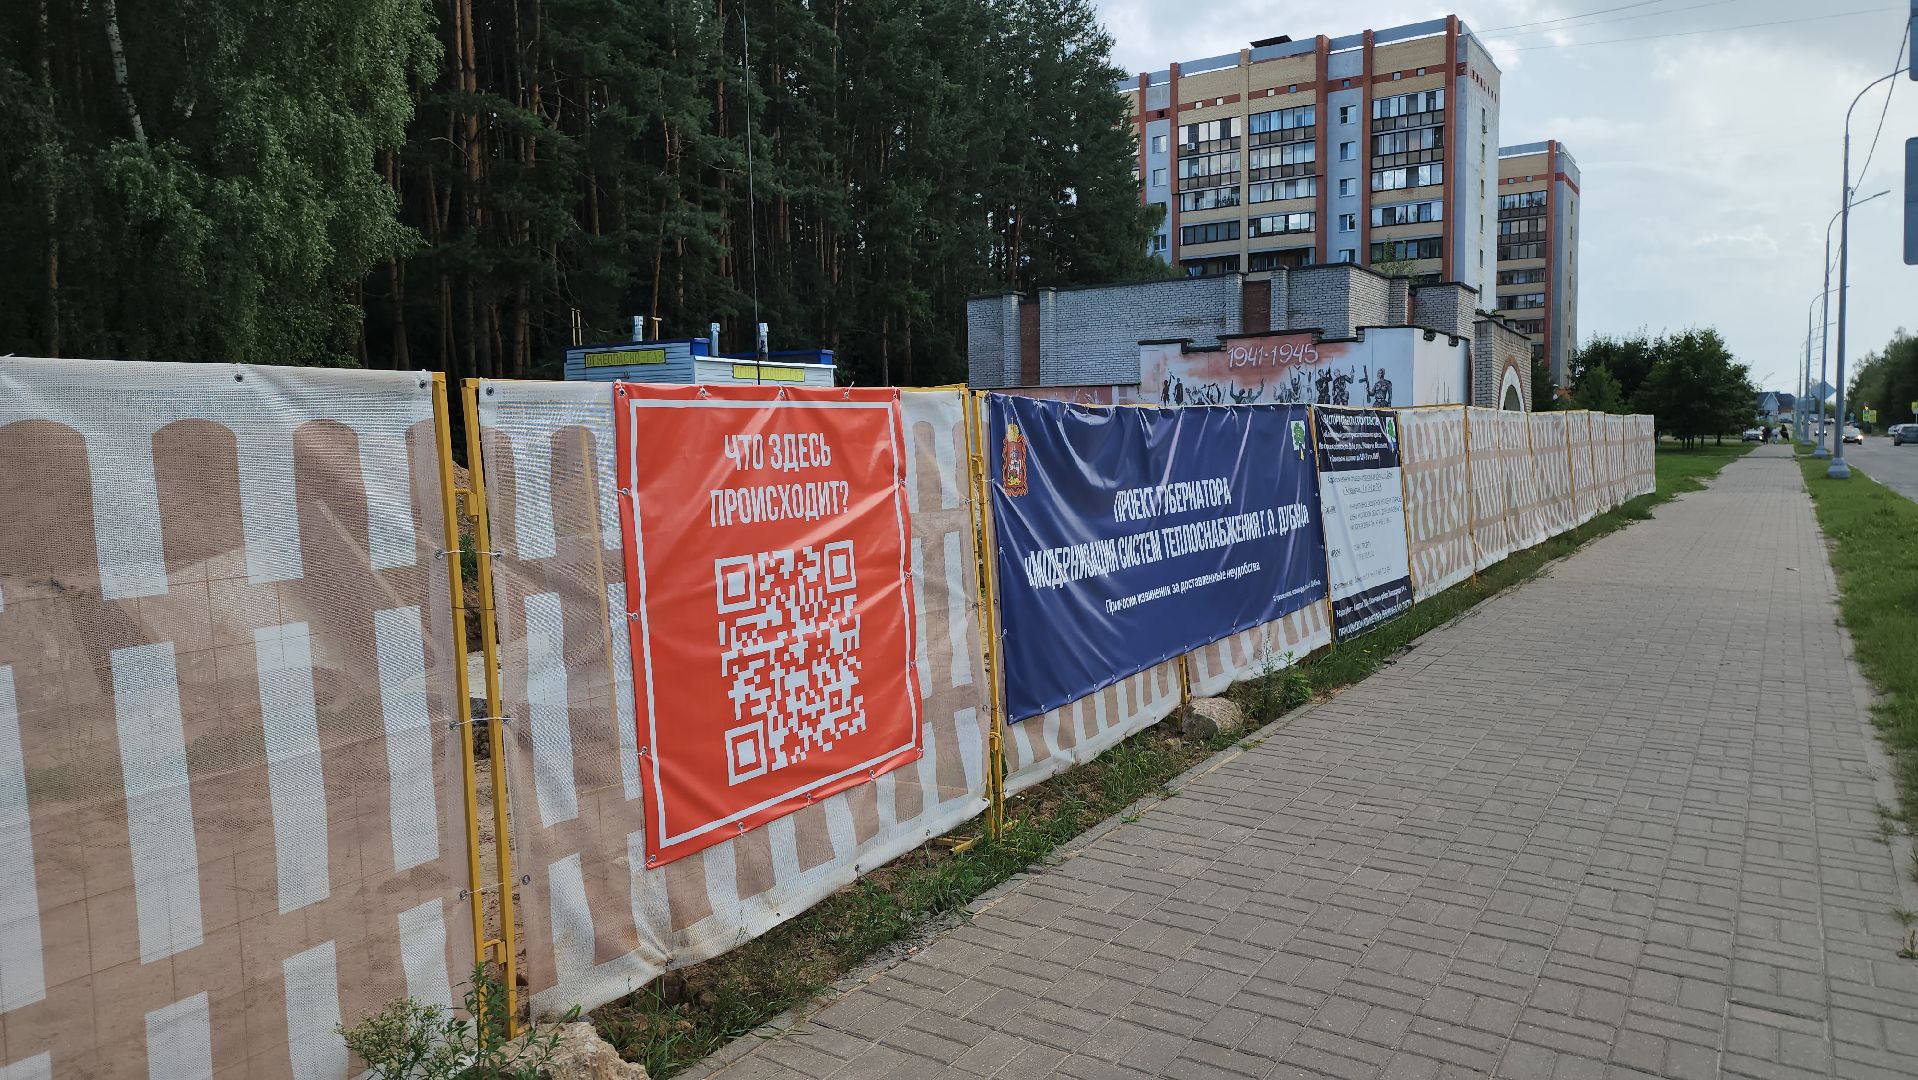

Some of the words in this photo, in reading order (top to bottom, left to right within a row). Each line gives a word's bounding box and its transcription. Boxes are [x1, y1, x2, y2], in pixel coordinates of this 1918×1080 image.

[724, 433, 764, 470] ЧТО
[768, 432, 831, 472] ЗДЕСЬ
[710, 480, 849, 527] ПРОИСХОДИТ?
[1114, 487, 1157, 522] ПРОЕКТ
[1156, 477, 1232, 516] ГУБЕРНАТОРА
[1025, 539, 1119, 590] «МОДЕРНИЗАЦИЯ
[1118, 529, 1162, 569] СИСТЕМ
[1161, 512, 1261, 559] ТЕПЛОСНАБЖЕНИЯ
[1105, 595, 1138, 615] Приносим
[1137, 586, 1172, 604] извинения
[1171, 583, 1180, 594] за
[1180, 570, 1227, 594] доставленные
